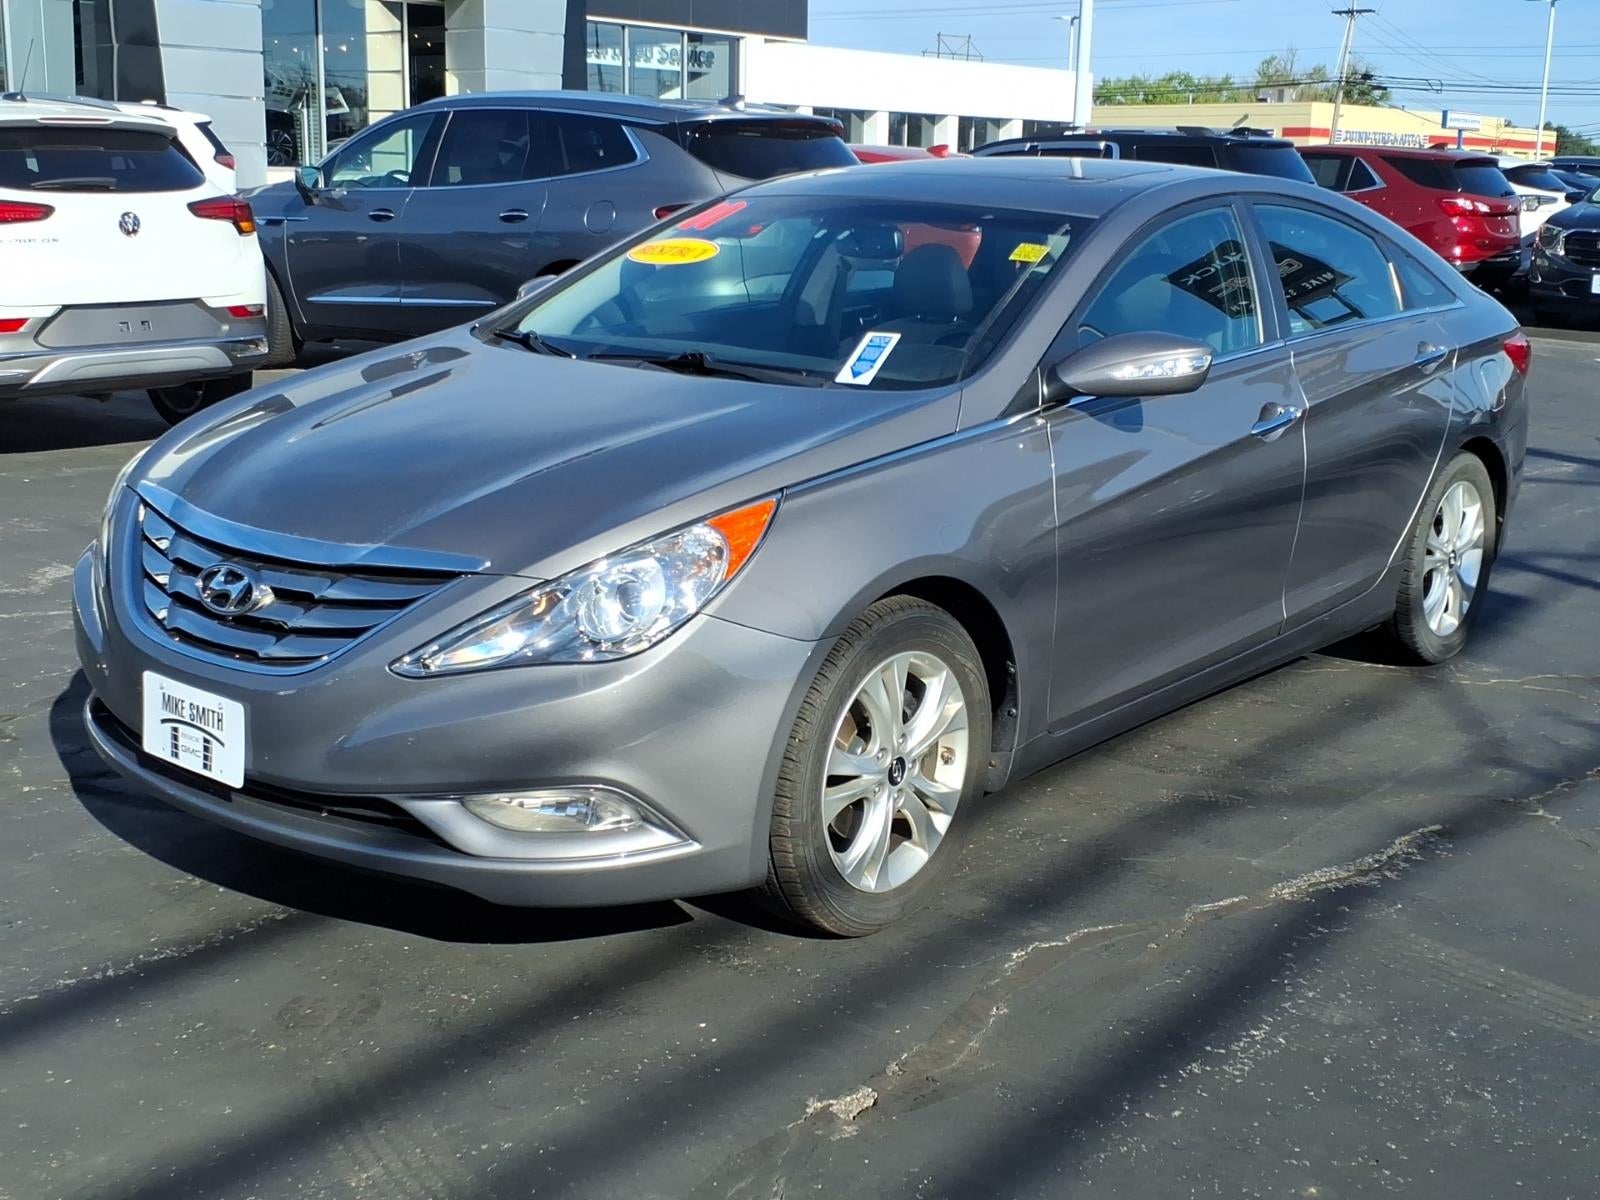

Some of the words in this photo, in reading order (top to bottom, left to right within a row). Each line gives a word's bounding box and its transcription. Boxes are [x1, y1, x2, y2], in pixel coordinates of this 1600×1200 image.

[658, 45, 715, 66] Sevice
[162, 691, 186, 719] MIKE
[189, 702, 224, 732] SMITH
